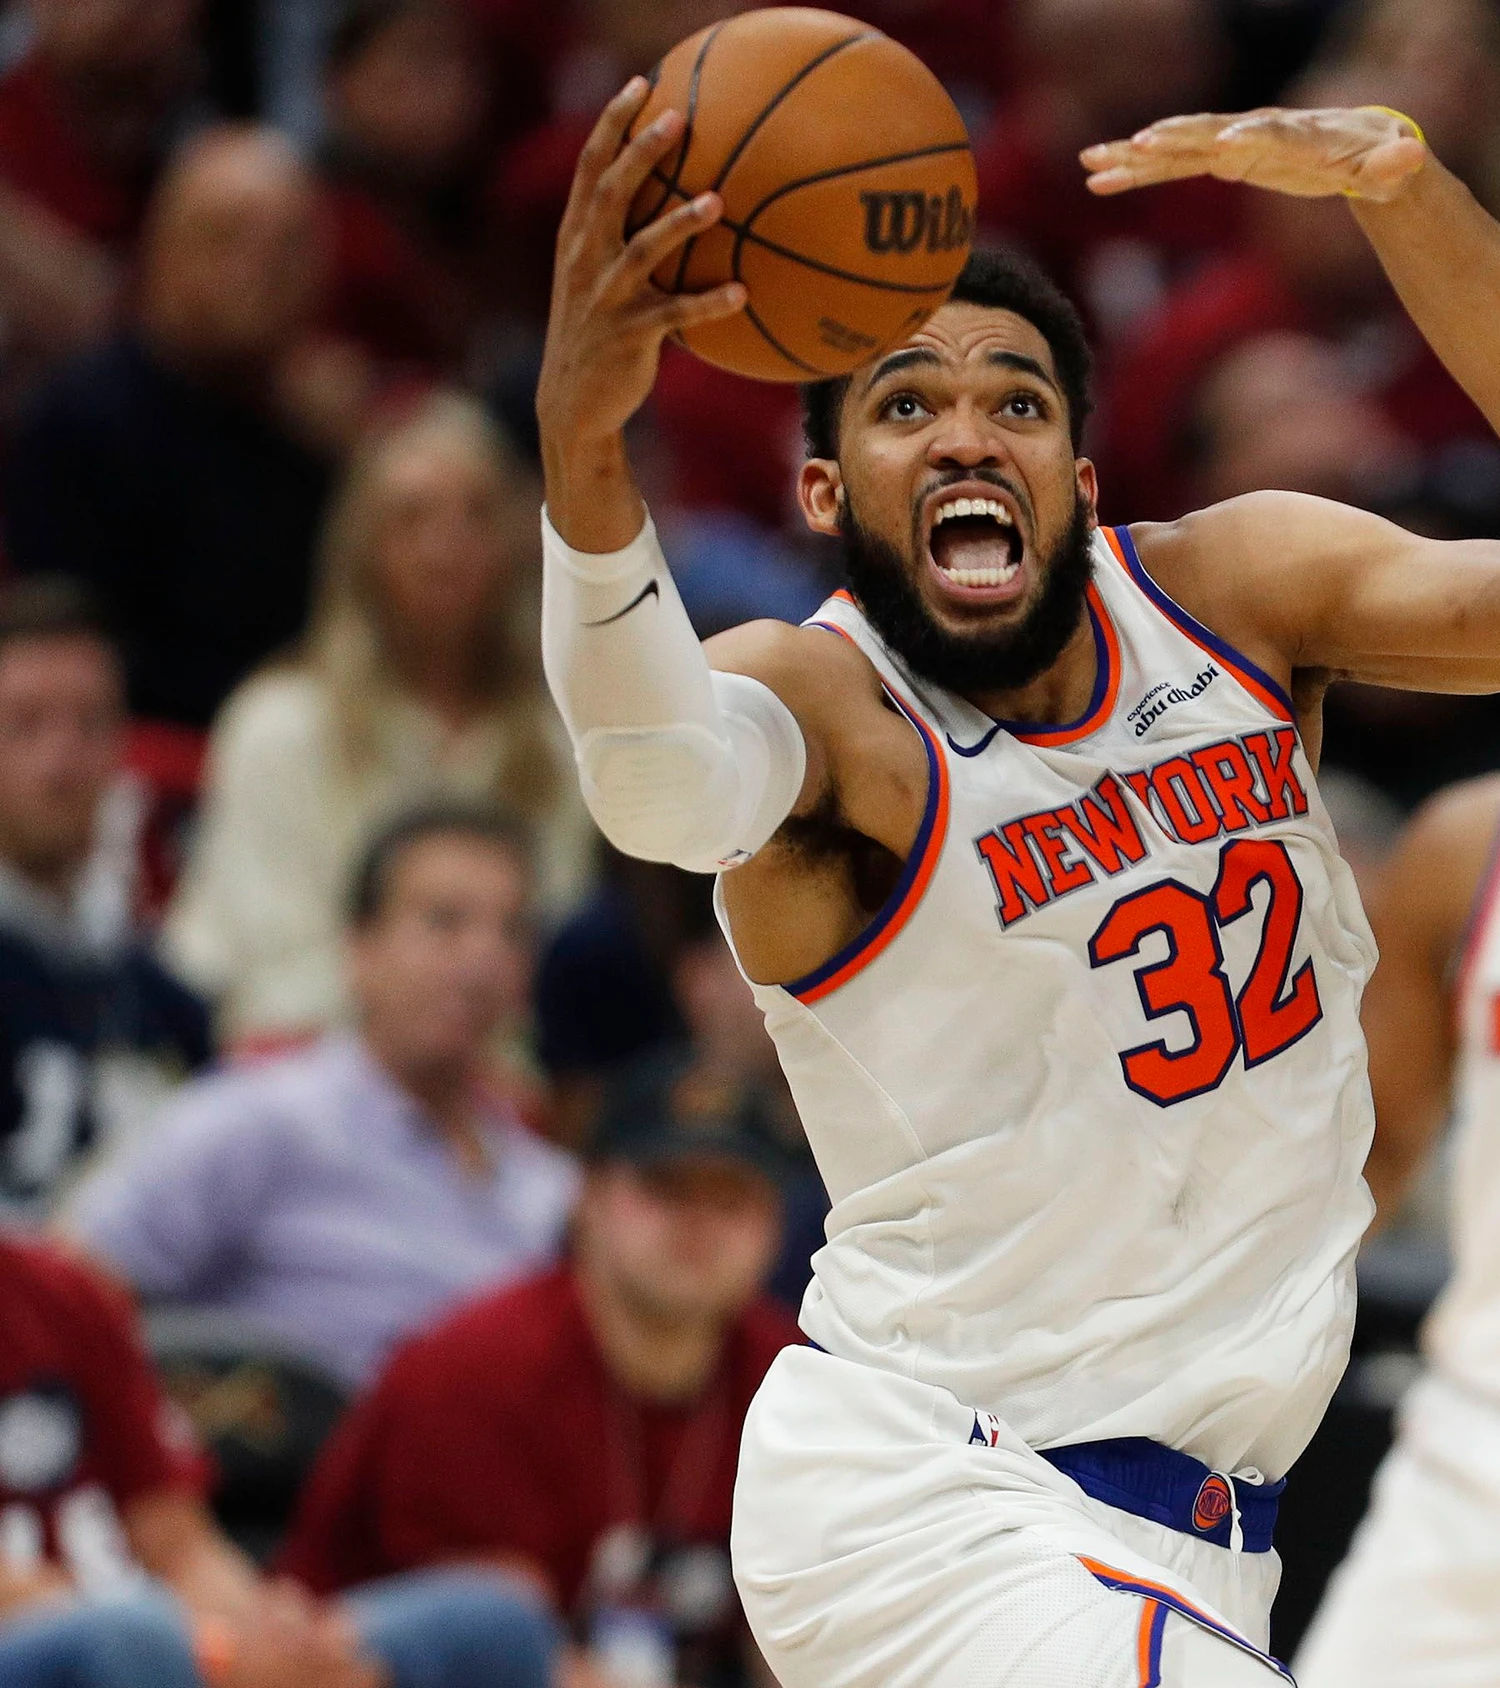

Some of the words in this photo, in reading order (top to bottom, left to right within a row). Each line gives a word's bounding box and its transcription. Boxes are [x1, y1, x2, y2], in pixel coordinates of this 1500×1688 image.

[1127, 682, 1171, 721] experience
[1135, 699, 1168, 737] abu
[1167, 663, 1219, 704] dhabi
[974, 767, 1151, 931] NEW
[1088, 838, 1324, 1108] 32
